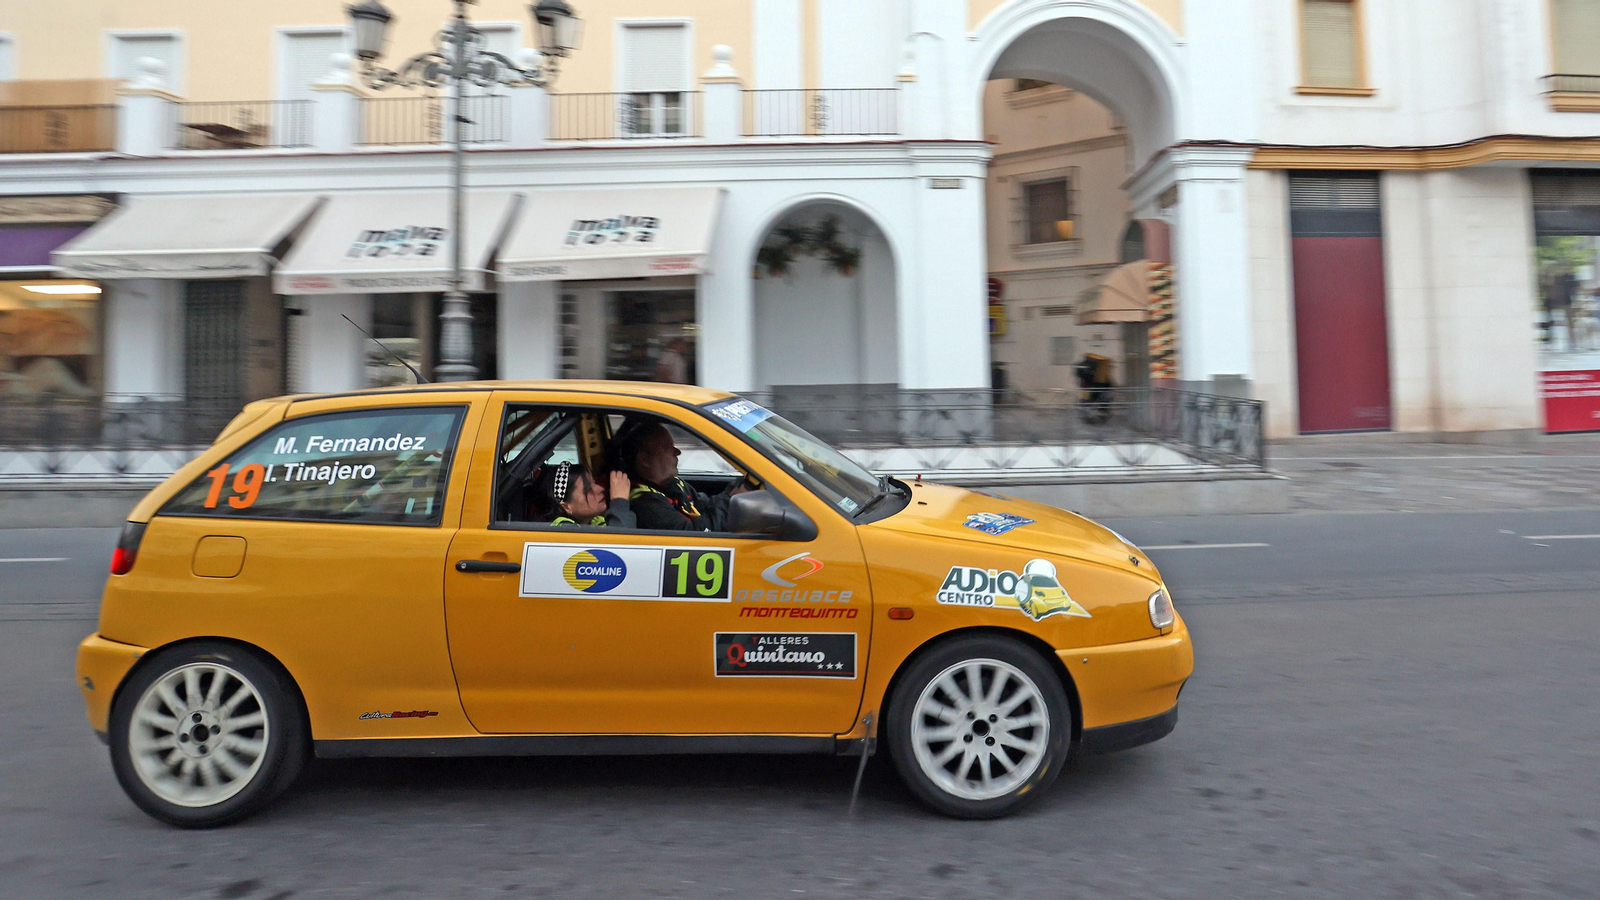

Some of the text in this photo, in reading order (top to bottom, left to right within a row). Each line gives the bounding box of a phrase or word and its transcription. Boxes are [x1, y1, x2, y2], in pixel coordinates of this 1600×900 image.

[273, 433, 427, 455] M. Fernandez
[283, 460, 376, 486] Tinajero
[203, 462, 266, 510] 19
[577, 566, 622, 577] COMLINE
[670, 551, 724, 597] 19
[938, 591, 994, 606] CENTRO
[751, 636, 810, 645] TALLERES
[726, 643, 826, 667] Quintano
